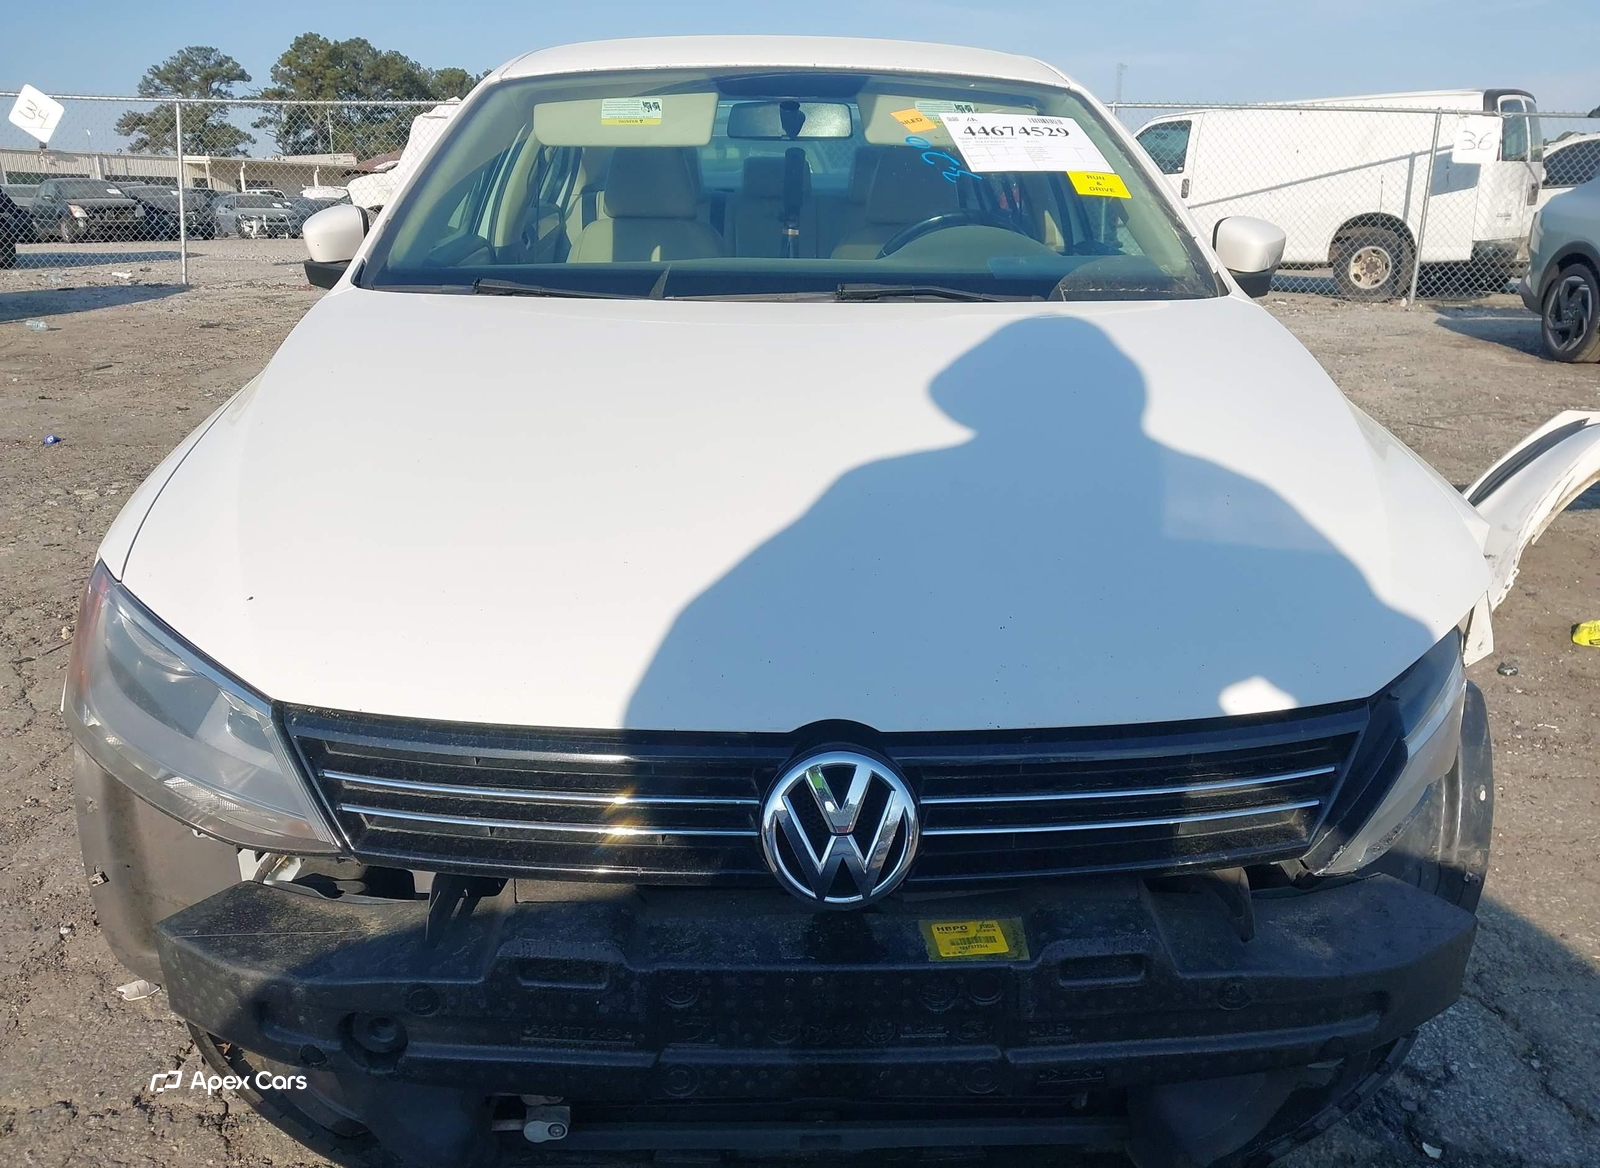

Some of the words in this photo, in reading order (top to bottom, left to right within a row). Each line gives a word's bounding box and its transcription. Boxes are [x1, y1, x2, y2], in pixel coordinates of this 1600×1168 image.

[18, 99, 50, 129] 34
[963, 125, 1070, 138] 44674529
[1461, 130, 1493, 151] 36
[936, 924, 968, 932] HBPO
